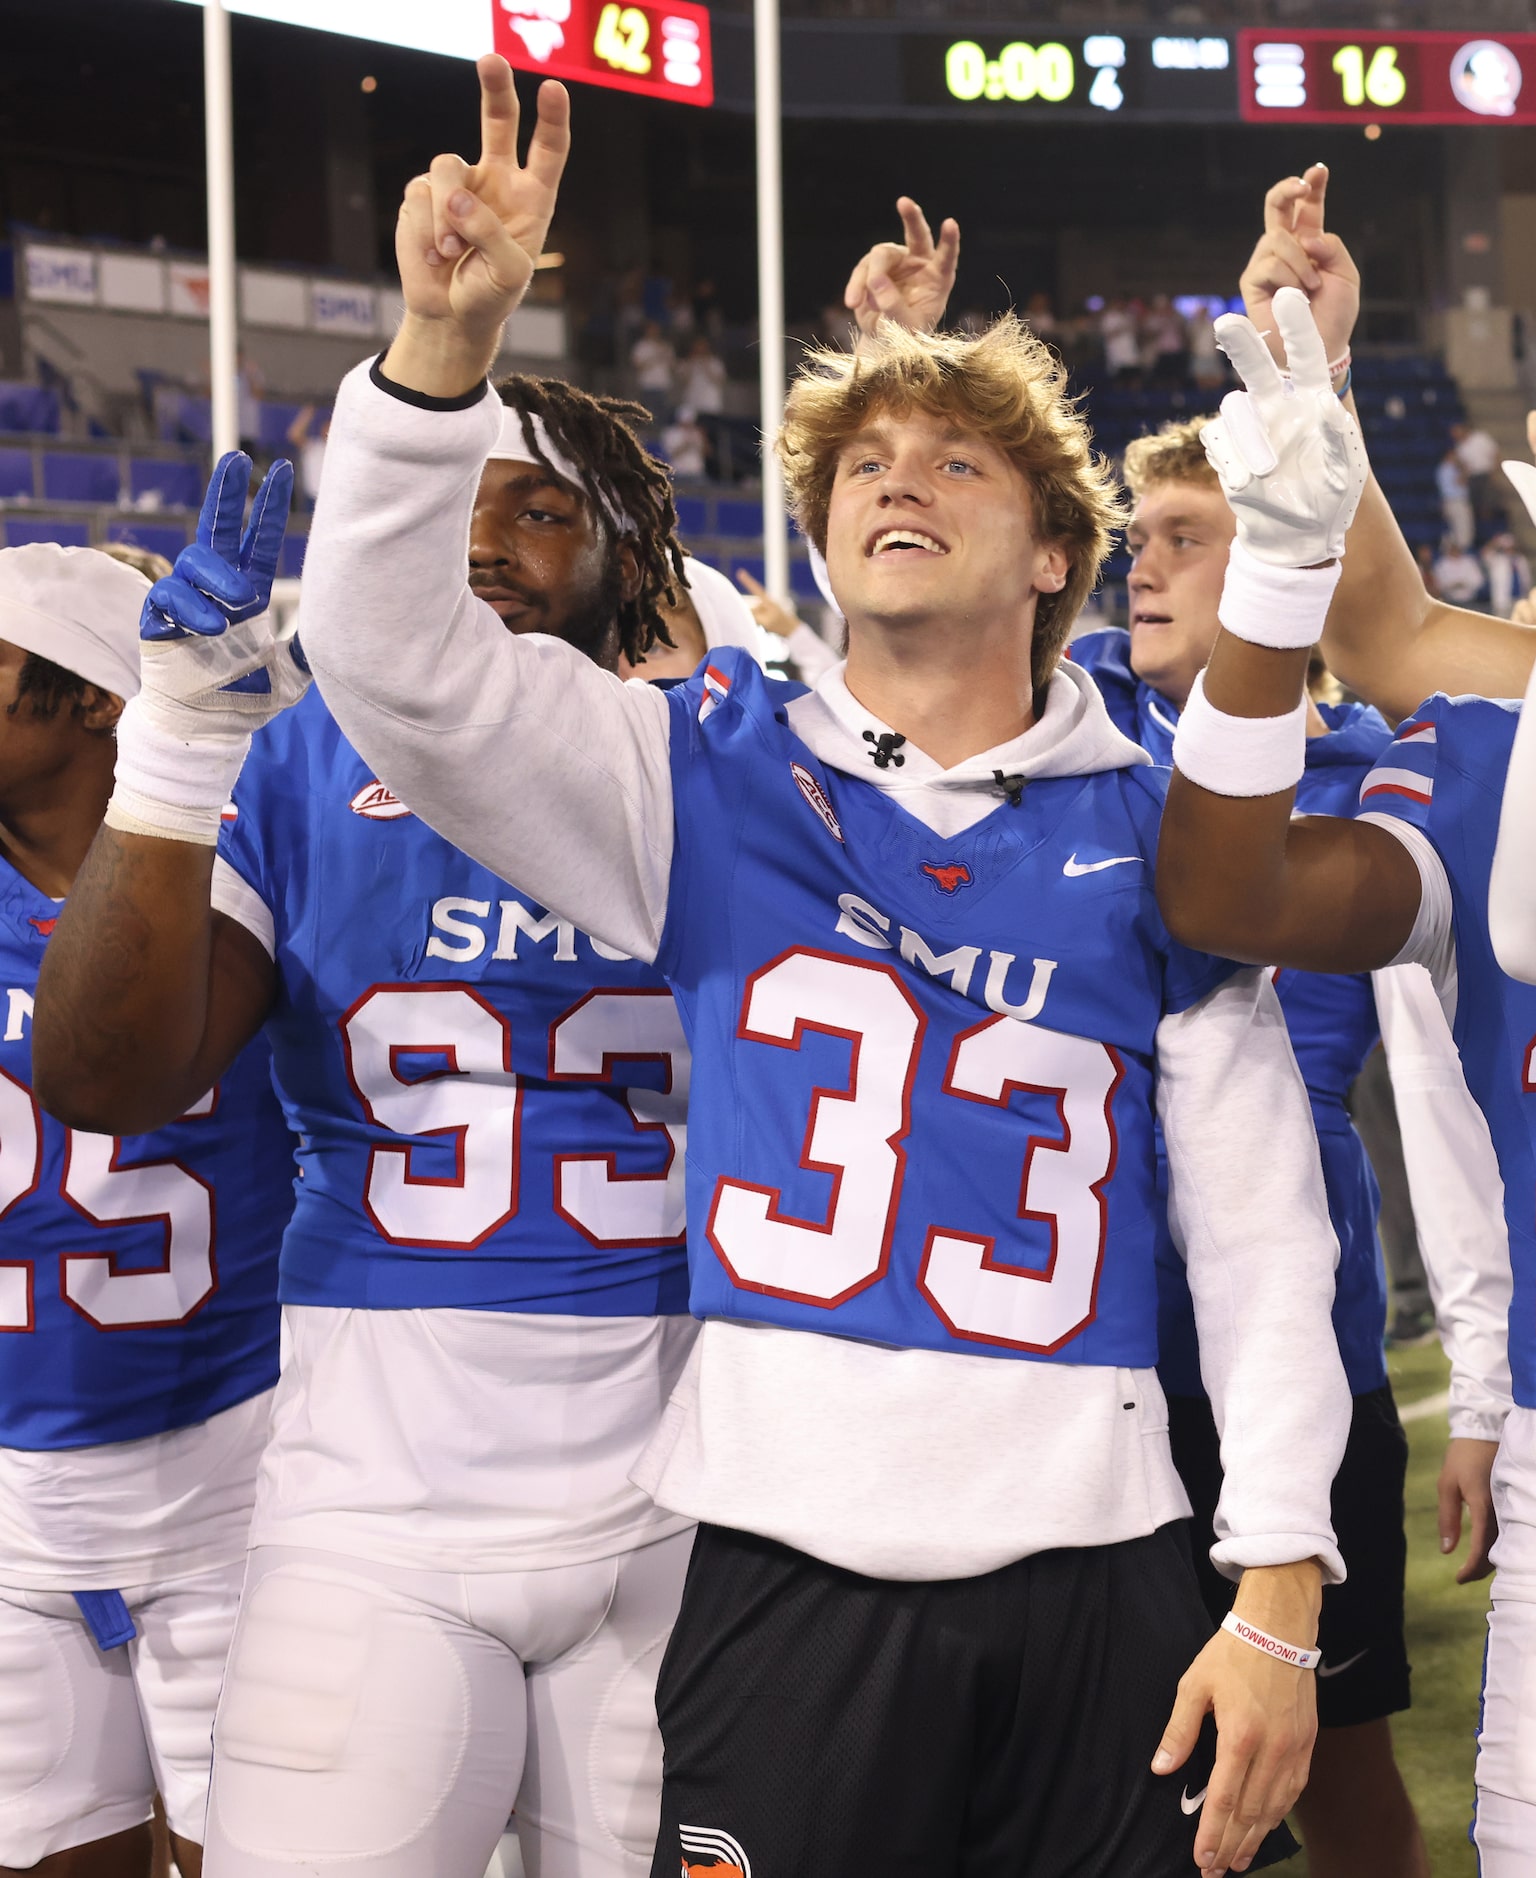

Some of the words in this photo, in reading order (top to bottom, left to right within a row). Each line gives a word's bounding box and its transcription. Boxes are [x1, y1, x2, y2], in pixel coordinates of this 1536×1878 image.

[594, 3, 652, 74] 42
[946, 41, 1074, 101] 0:00
[1089, 66, 1123, 110] 4
[1332, 45, 1406, 107] 16
[799, 775, 838, 829] ACC
[834, 893, 1058, 1021] SMU
[337, 981, 688, 1250] 93
[706, 945, 1126, 1355] 33
[1235, 1622, 1298, 1662] UNCOMMON
